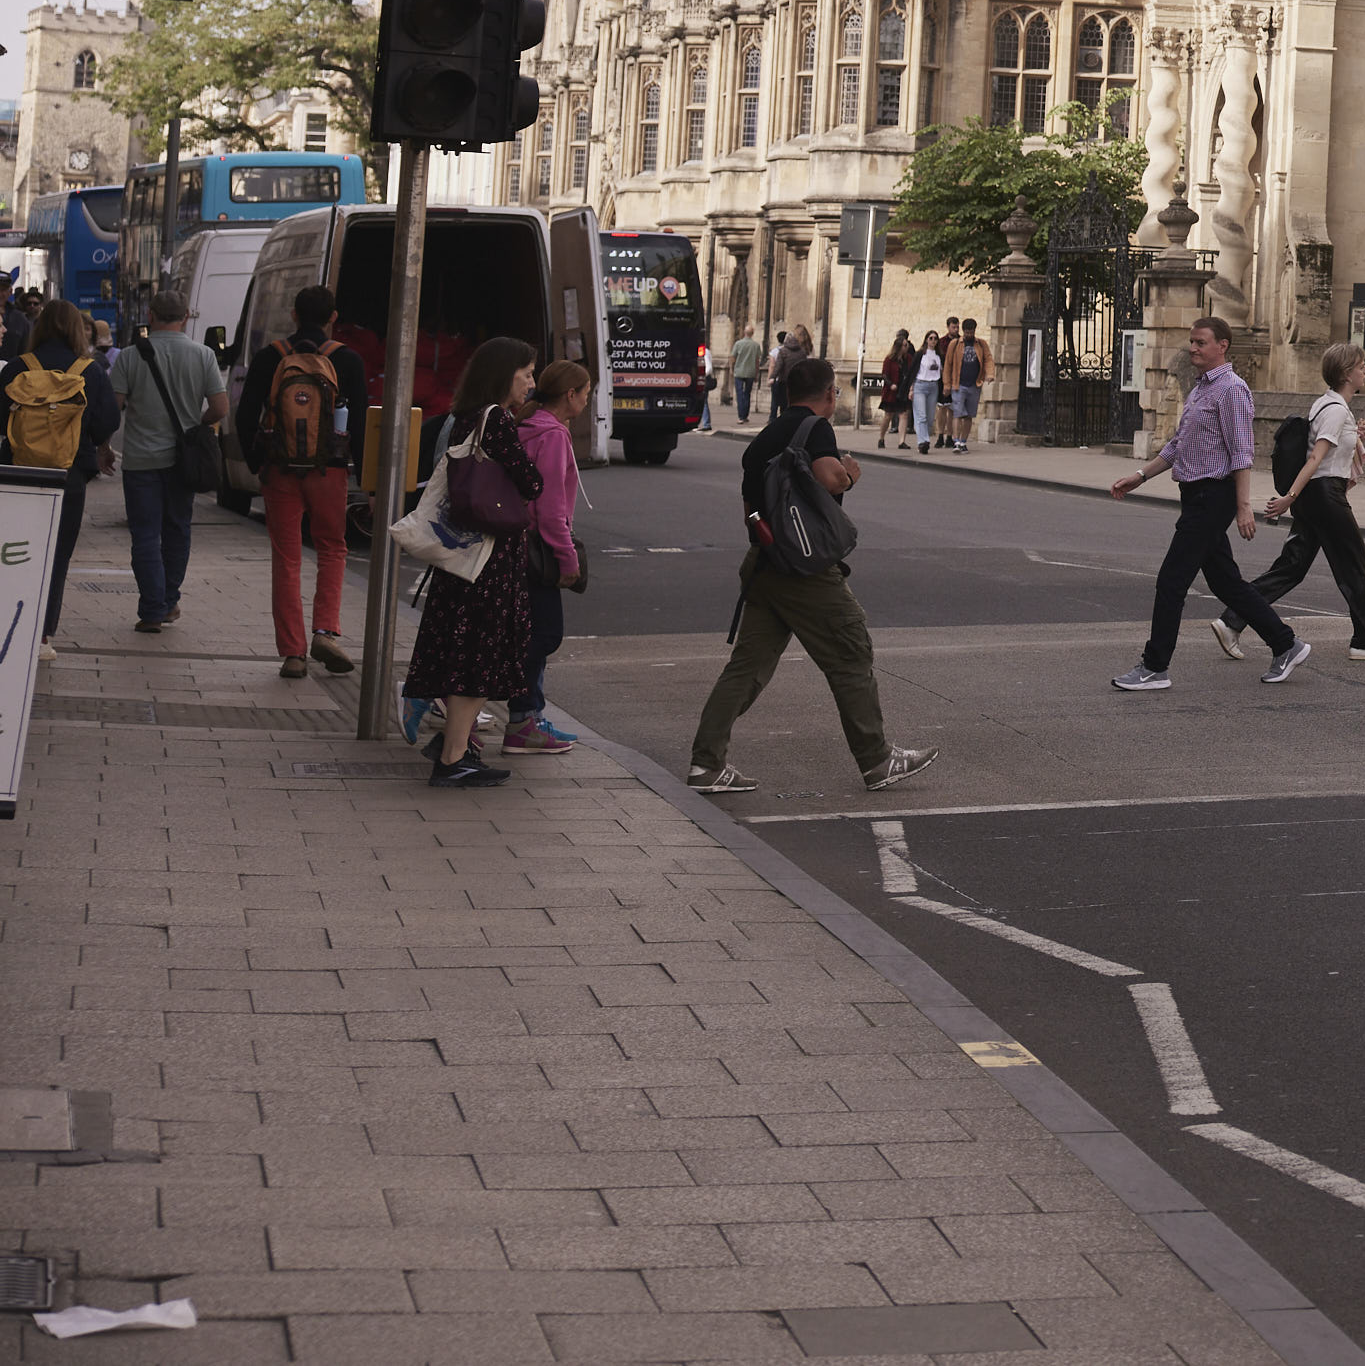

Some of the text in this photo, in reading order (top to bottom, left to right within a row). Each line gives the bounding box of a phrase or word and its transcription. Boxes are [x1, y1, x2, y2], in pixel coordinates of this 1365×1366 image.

[636, 340, 652, 348] THE
[653, 340, 671, 348] APP
[613, 361, 666, 369] COME TO YOU
[863, 379, 874, 387] ST
